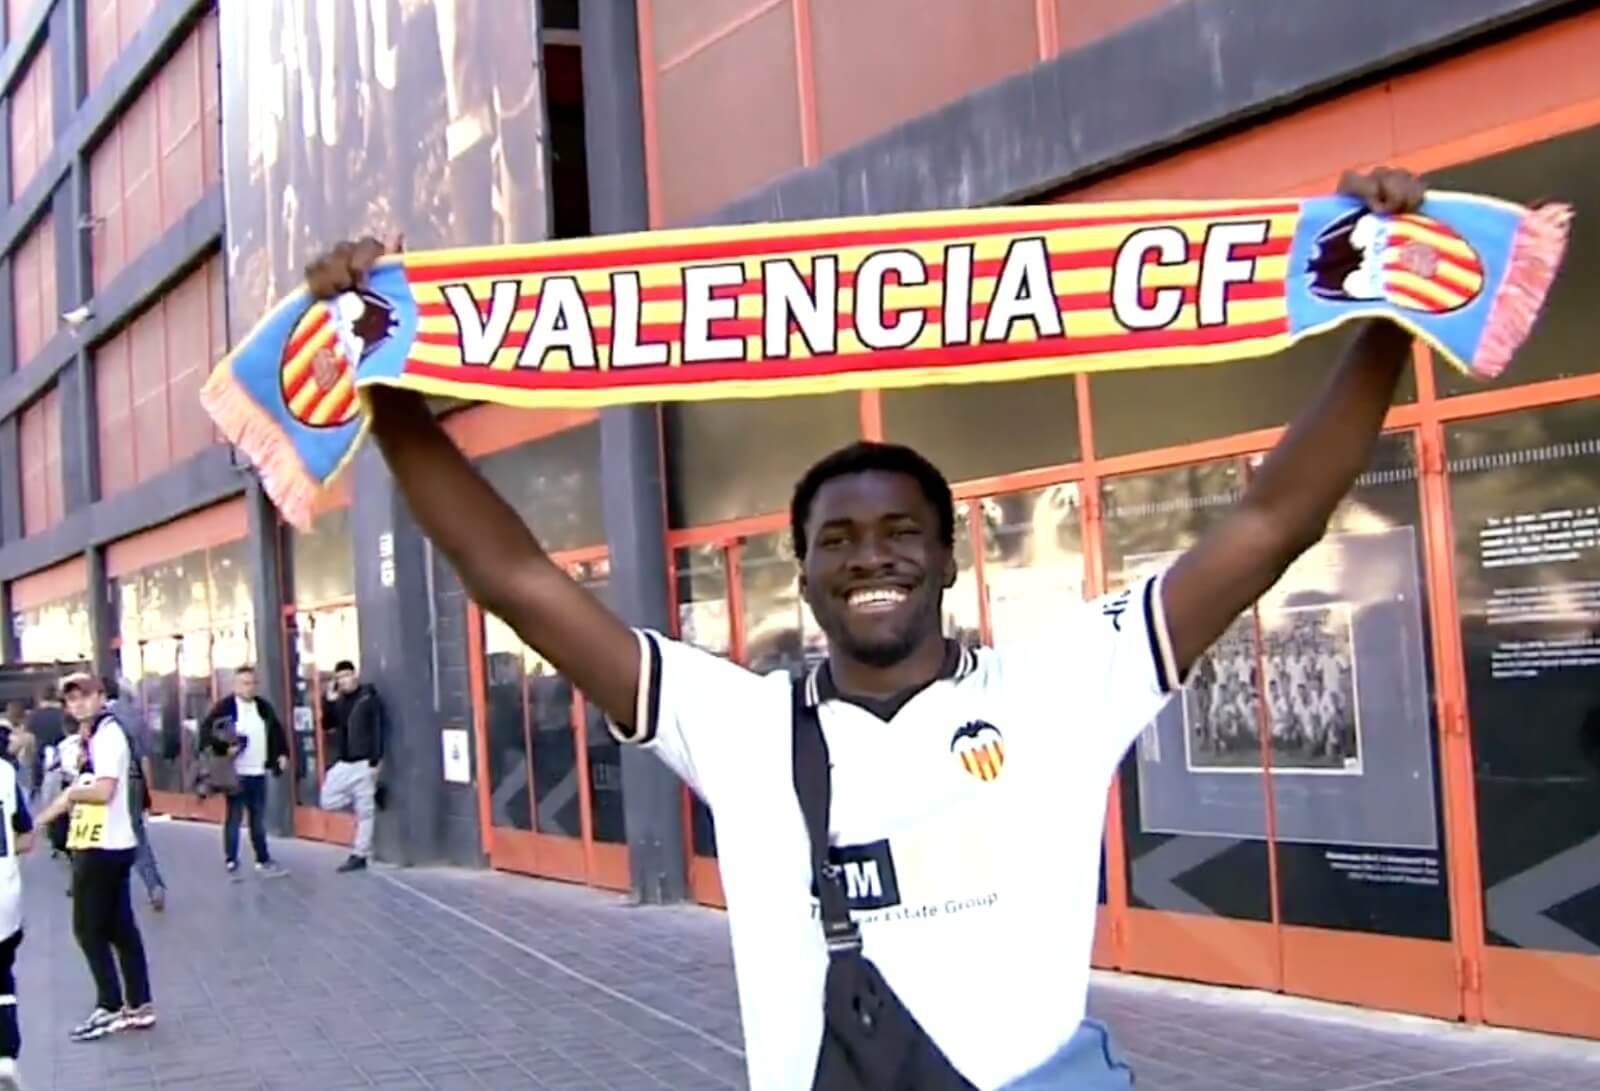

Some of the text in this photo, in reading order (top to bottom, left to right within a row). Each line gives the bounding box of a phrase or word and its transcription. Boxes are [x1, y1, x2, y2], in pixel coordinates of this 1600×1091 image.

[439, 235, 1066, 370] VALENCIA
[1110, 219, 1271, 331] CF
[944, 892, 998, 914] Group
